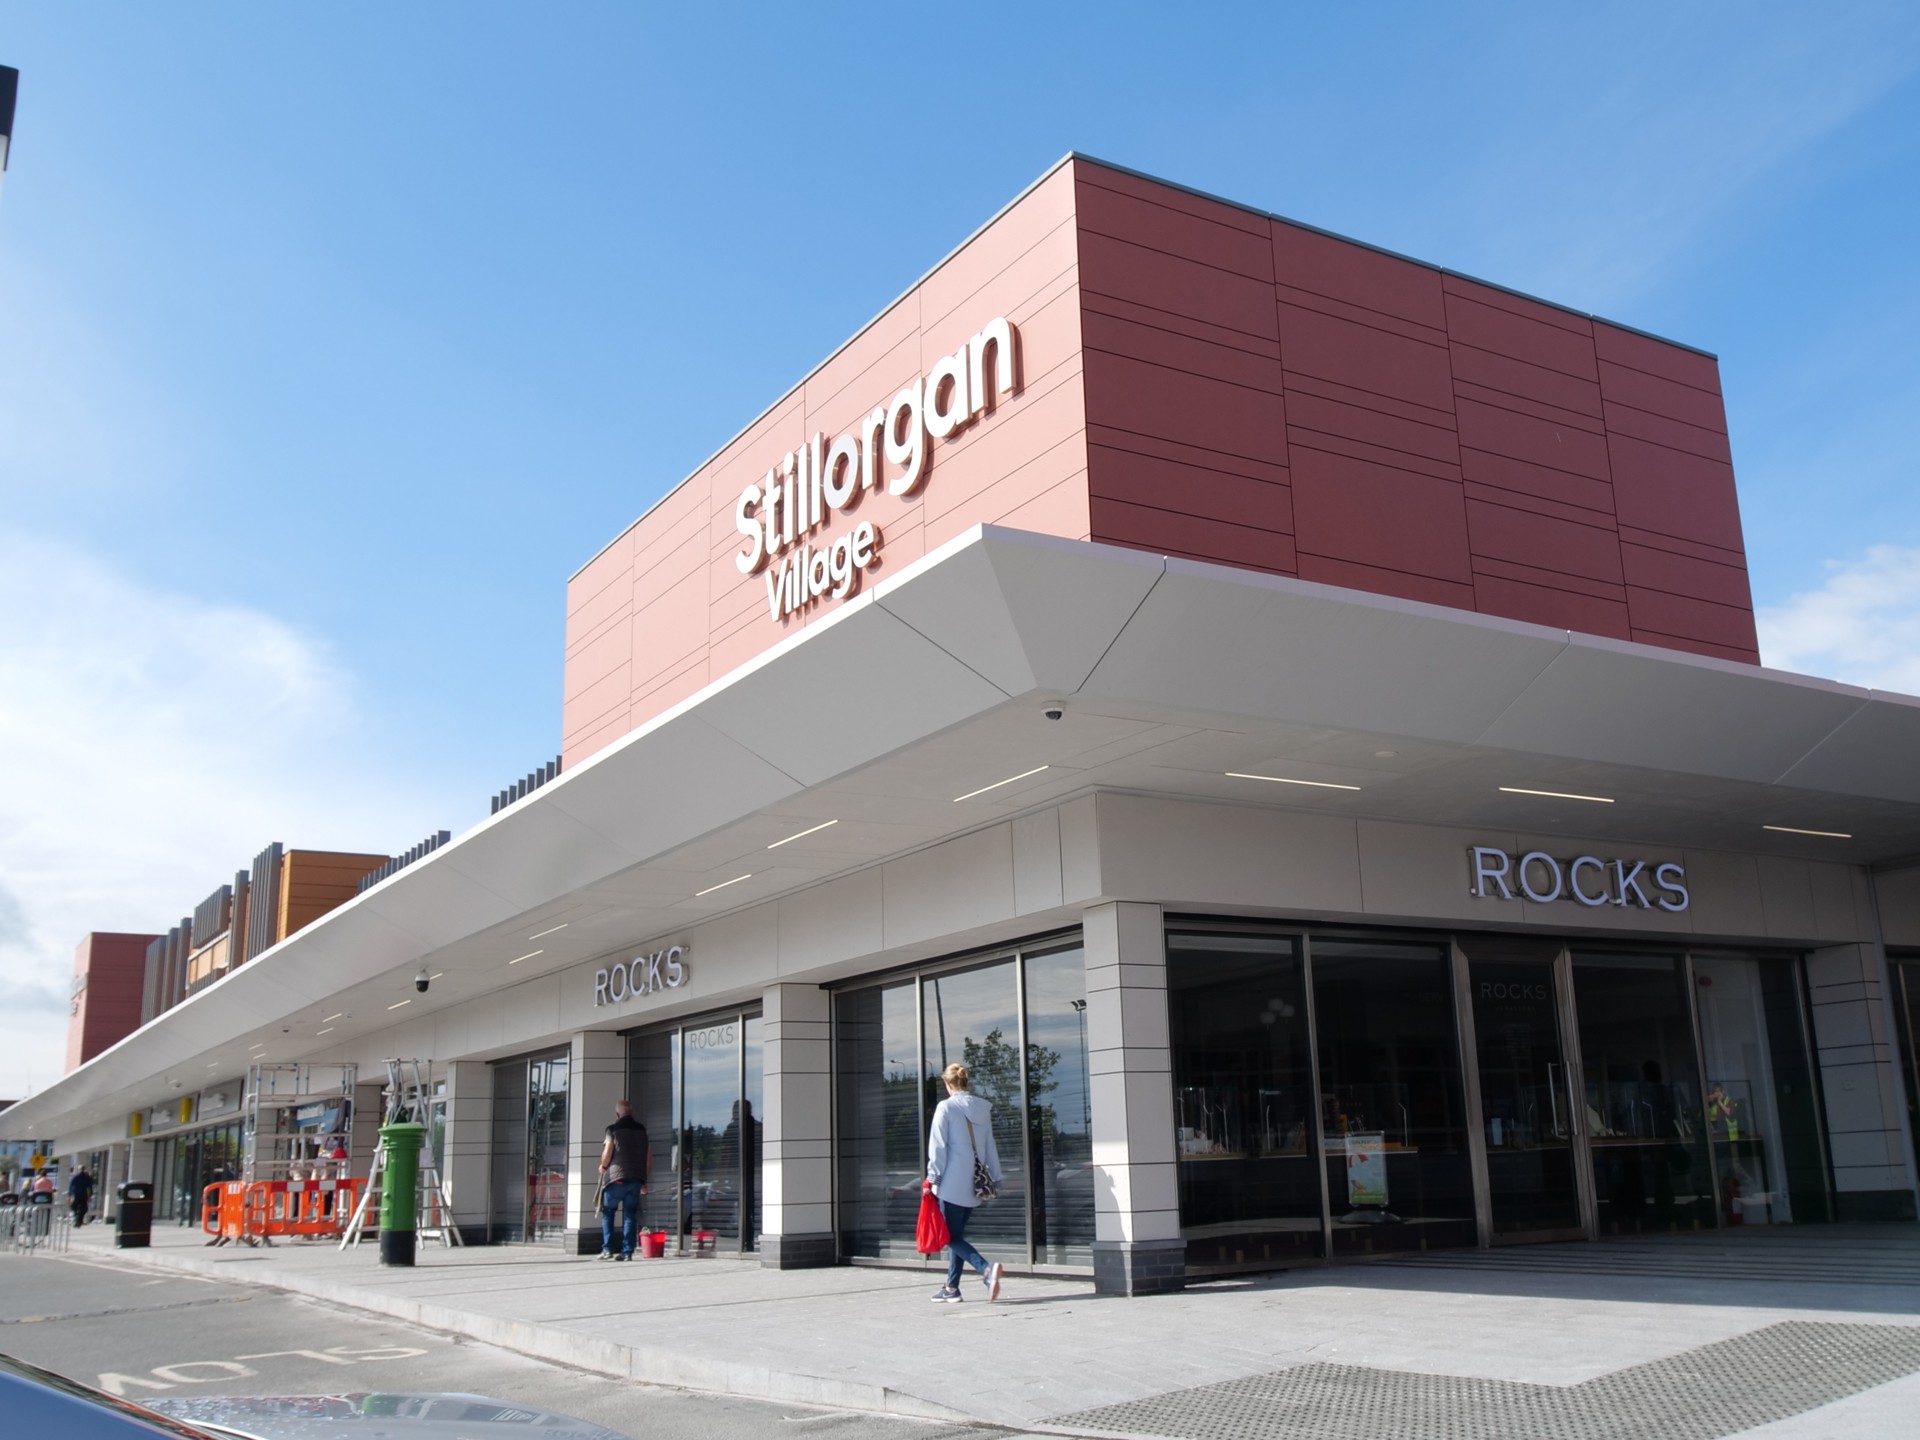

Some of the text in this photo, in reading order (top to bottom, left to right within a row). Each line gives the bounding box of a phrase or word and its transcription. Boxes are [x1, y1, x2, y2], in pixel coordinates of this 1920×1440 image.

[736, 317, 1015, 574] Stillorgan
[764, 521, 879, 622] Village
[1472, 846, 1689, 912] ROCKS
[594, 945, 687, 1007] ROCKS
[1480, 982, 1547, 1000] ROCKS
[690, 1025, 734, 1051] ROCKS
